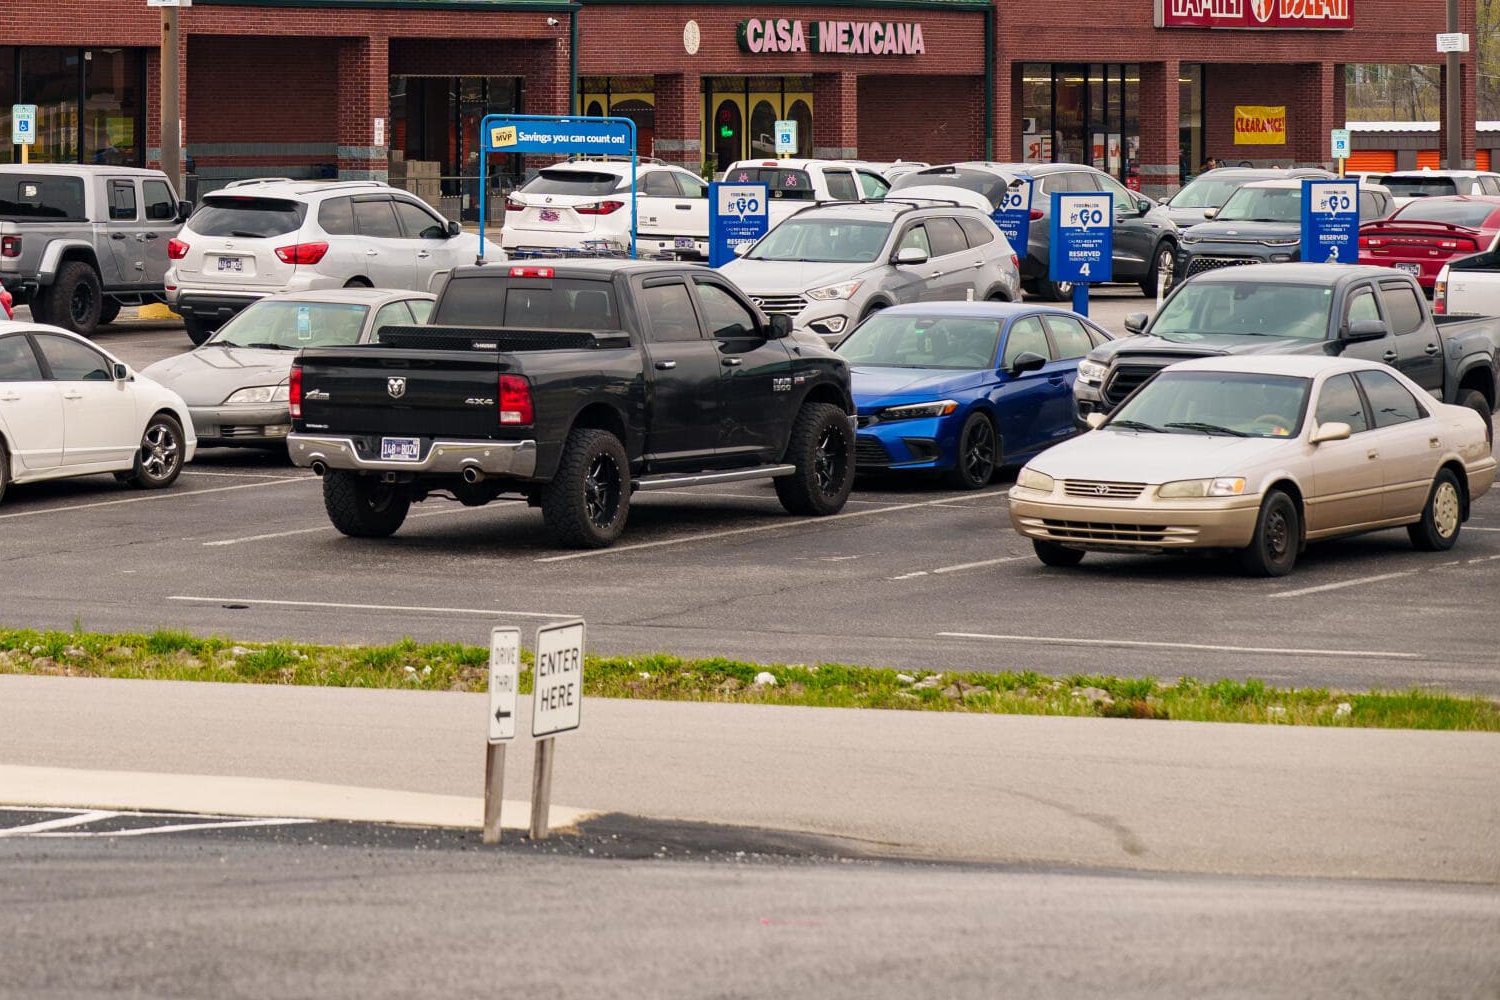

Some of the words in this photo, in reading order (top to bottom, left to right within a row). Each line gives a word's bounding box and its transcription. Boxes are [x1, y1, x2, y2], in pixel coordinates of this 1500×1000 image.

[746, 18, 807, 53] CASA
[818, 20, 926, 55] MEXICANA
[1236, 117, 1285, 133] CLEARANCE!
[495, 133, 512, 142] MVP
[518, 131, 552, 144] Savings
[553, 134, 569, 144] you
[570, 135, 586, 143] can
[586, 134, 611, 143] count
[611, 134, 626, 144] on!
[736, 198, 759, 215] GO
[1329, 195, 1350, 212] GO
[1079, 209, 1103, 226] GO
[1329, 245, 1339, 259] 3
[1079, 262, 1091, 277] 4
[495, 647, 516, 665] DRIVE
[540, 647, 579, 677] ENTER
[495, 674, 514, 693] THRU
[541, 683, 574, 712] HERE
